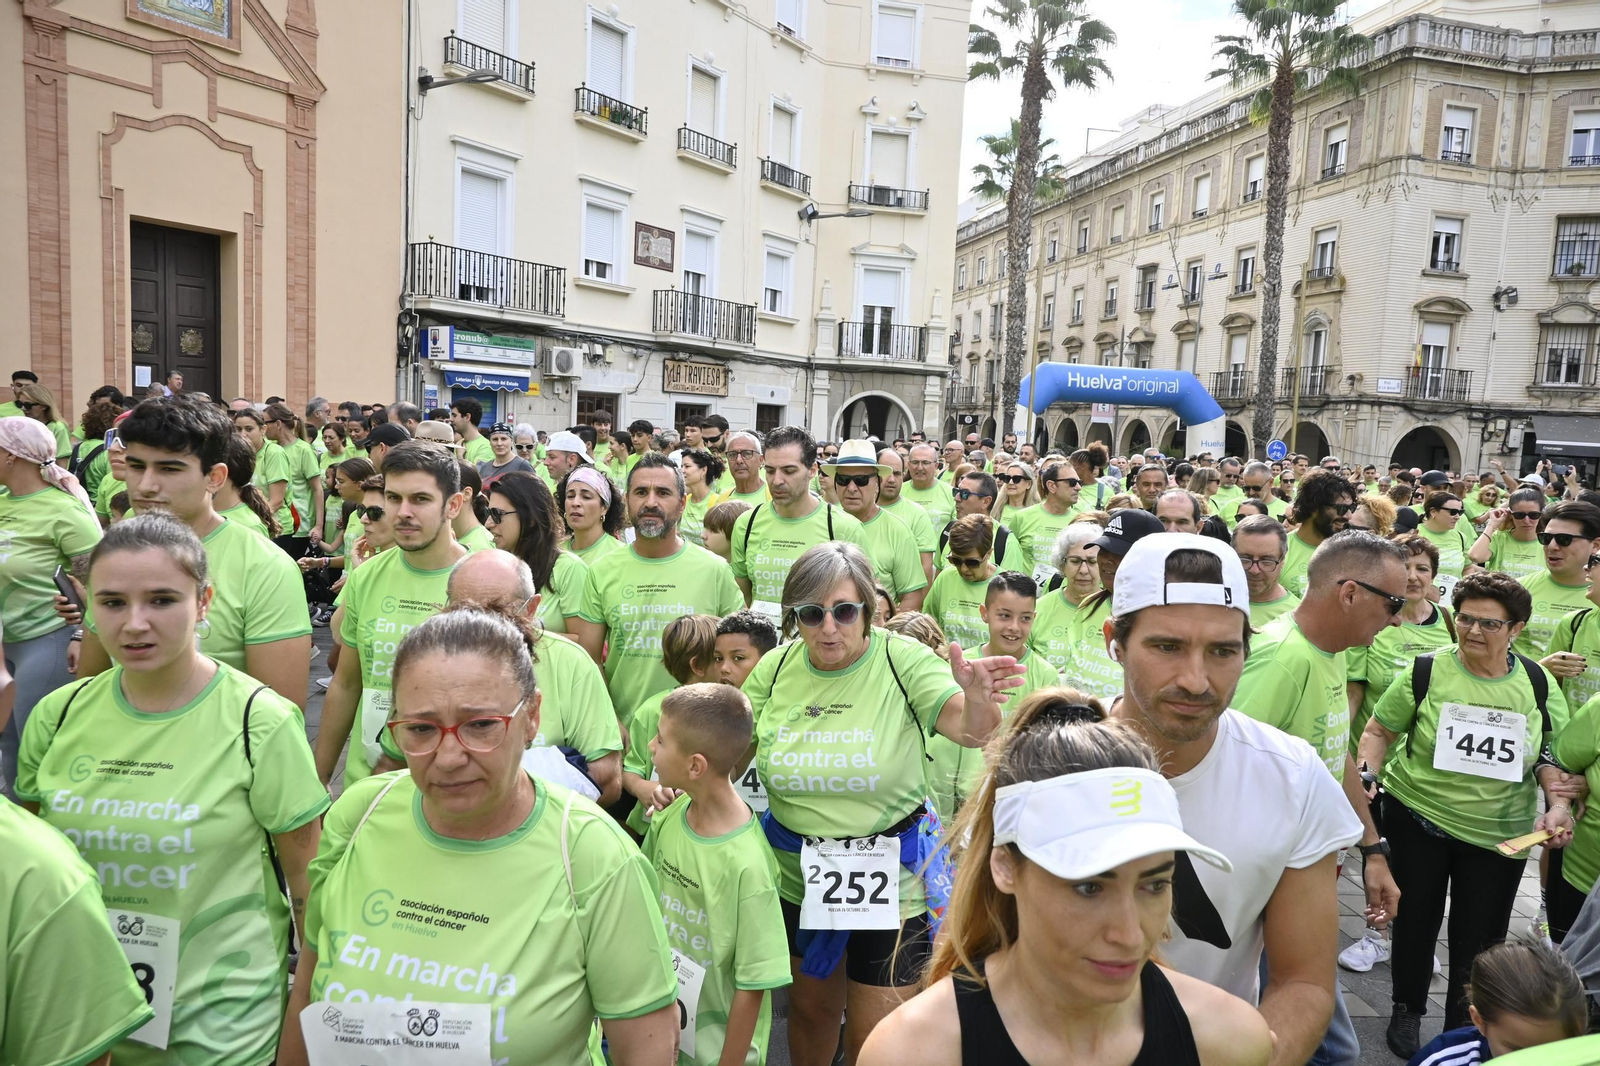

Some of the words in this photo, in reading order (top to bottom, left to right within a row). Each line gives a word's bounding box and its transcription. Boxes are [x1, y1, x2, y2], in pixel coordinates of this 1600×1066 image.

[672, 364, 681, 382] LA
[1068, 372, 1122, 390] Huelva
[1127, 377, 1179, 396] original
[755, 554, 769, 564] En
[621, 603, 638, 615] En
[642, 602, 694, 615] marcha
[376, 618, 396, 633] En
[1532, 614, 1549, 625] En
[1049, 640, 1064, 649] En
[777, 726, 799, 743] En
[803, 728, 875, 744] marcha
[100, 758, 140, 768] asociación
[140, 759, 173, 770] española
[770, 749, 848, 768] contra
[852, 748, 876, 767] el
[122, 768, 130, 776] el
[131, 768, 155, 778] cáncer
[770, 769, 880, 792] cáncer
[52, 789, 87, 814] En
[91, 796, 200, 821] marcha
[63, 825, 152, 853] ontra
[158, 827, 195, 855] el
[98, 860, 197, 890] ncer
[113, 896, 148, 904] HUELVA
[400, 897, 444, 914] asociación
[446, 908, 490, 924] española
[391, 922, 402, 930] en
[404, 921, 438, 938] Huelva
[396, 909, 424, 923] contra
[425, 914, 433, 924] el
[434, 916, 466, 932] cáncer
[339, 934, 380, 971] En
[386, 948, 517, 998] marcha
[340, 1036, 363, 1046] MARCHA
[365, 1038, 390, 1047] CONTRA
[425, 1040, 434, 1049] EN
[435, 1041, 460, 1050] HUELVA
